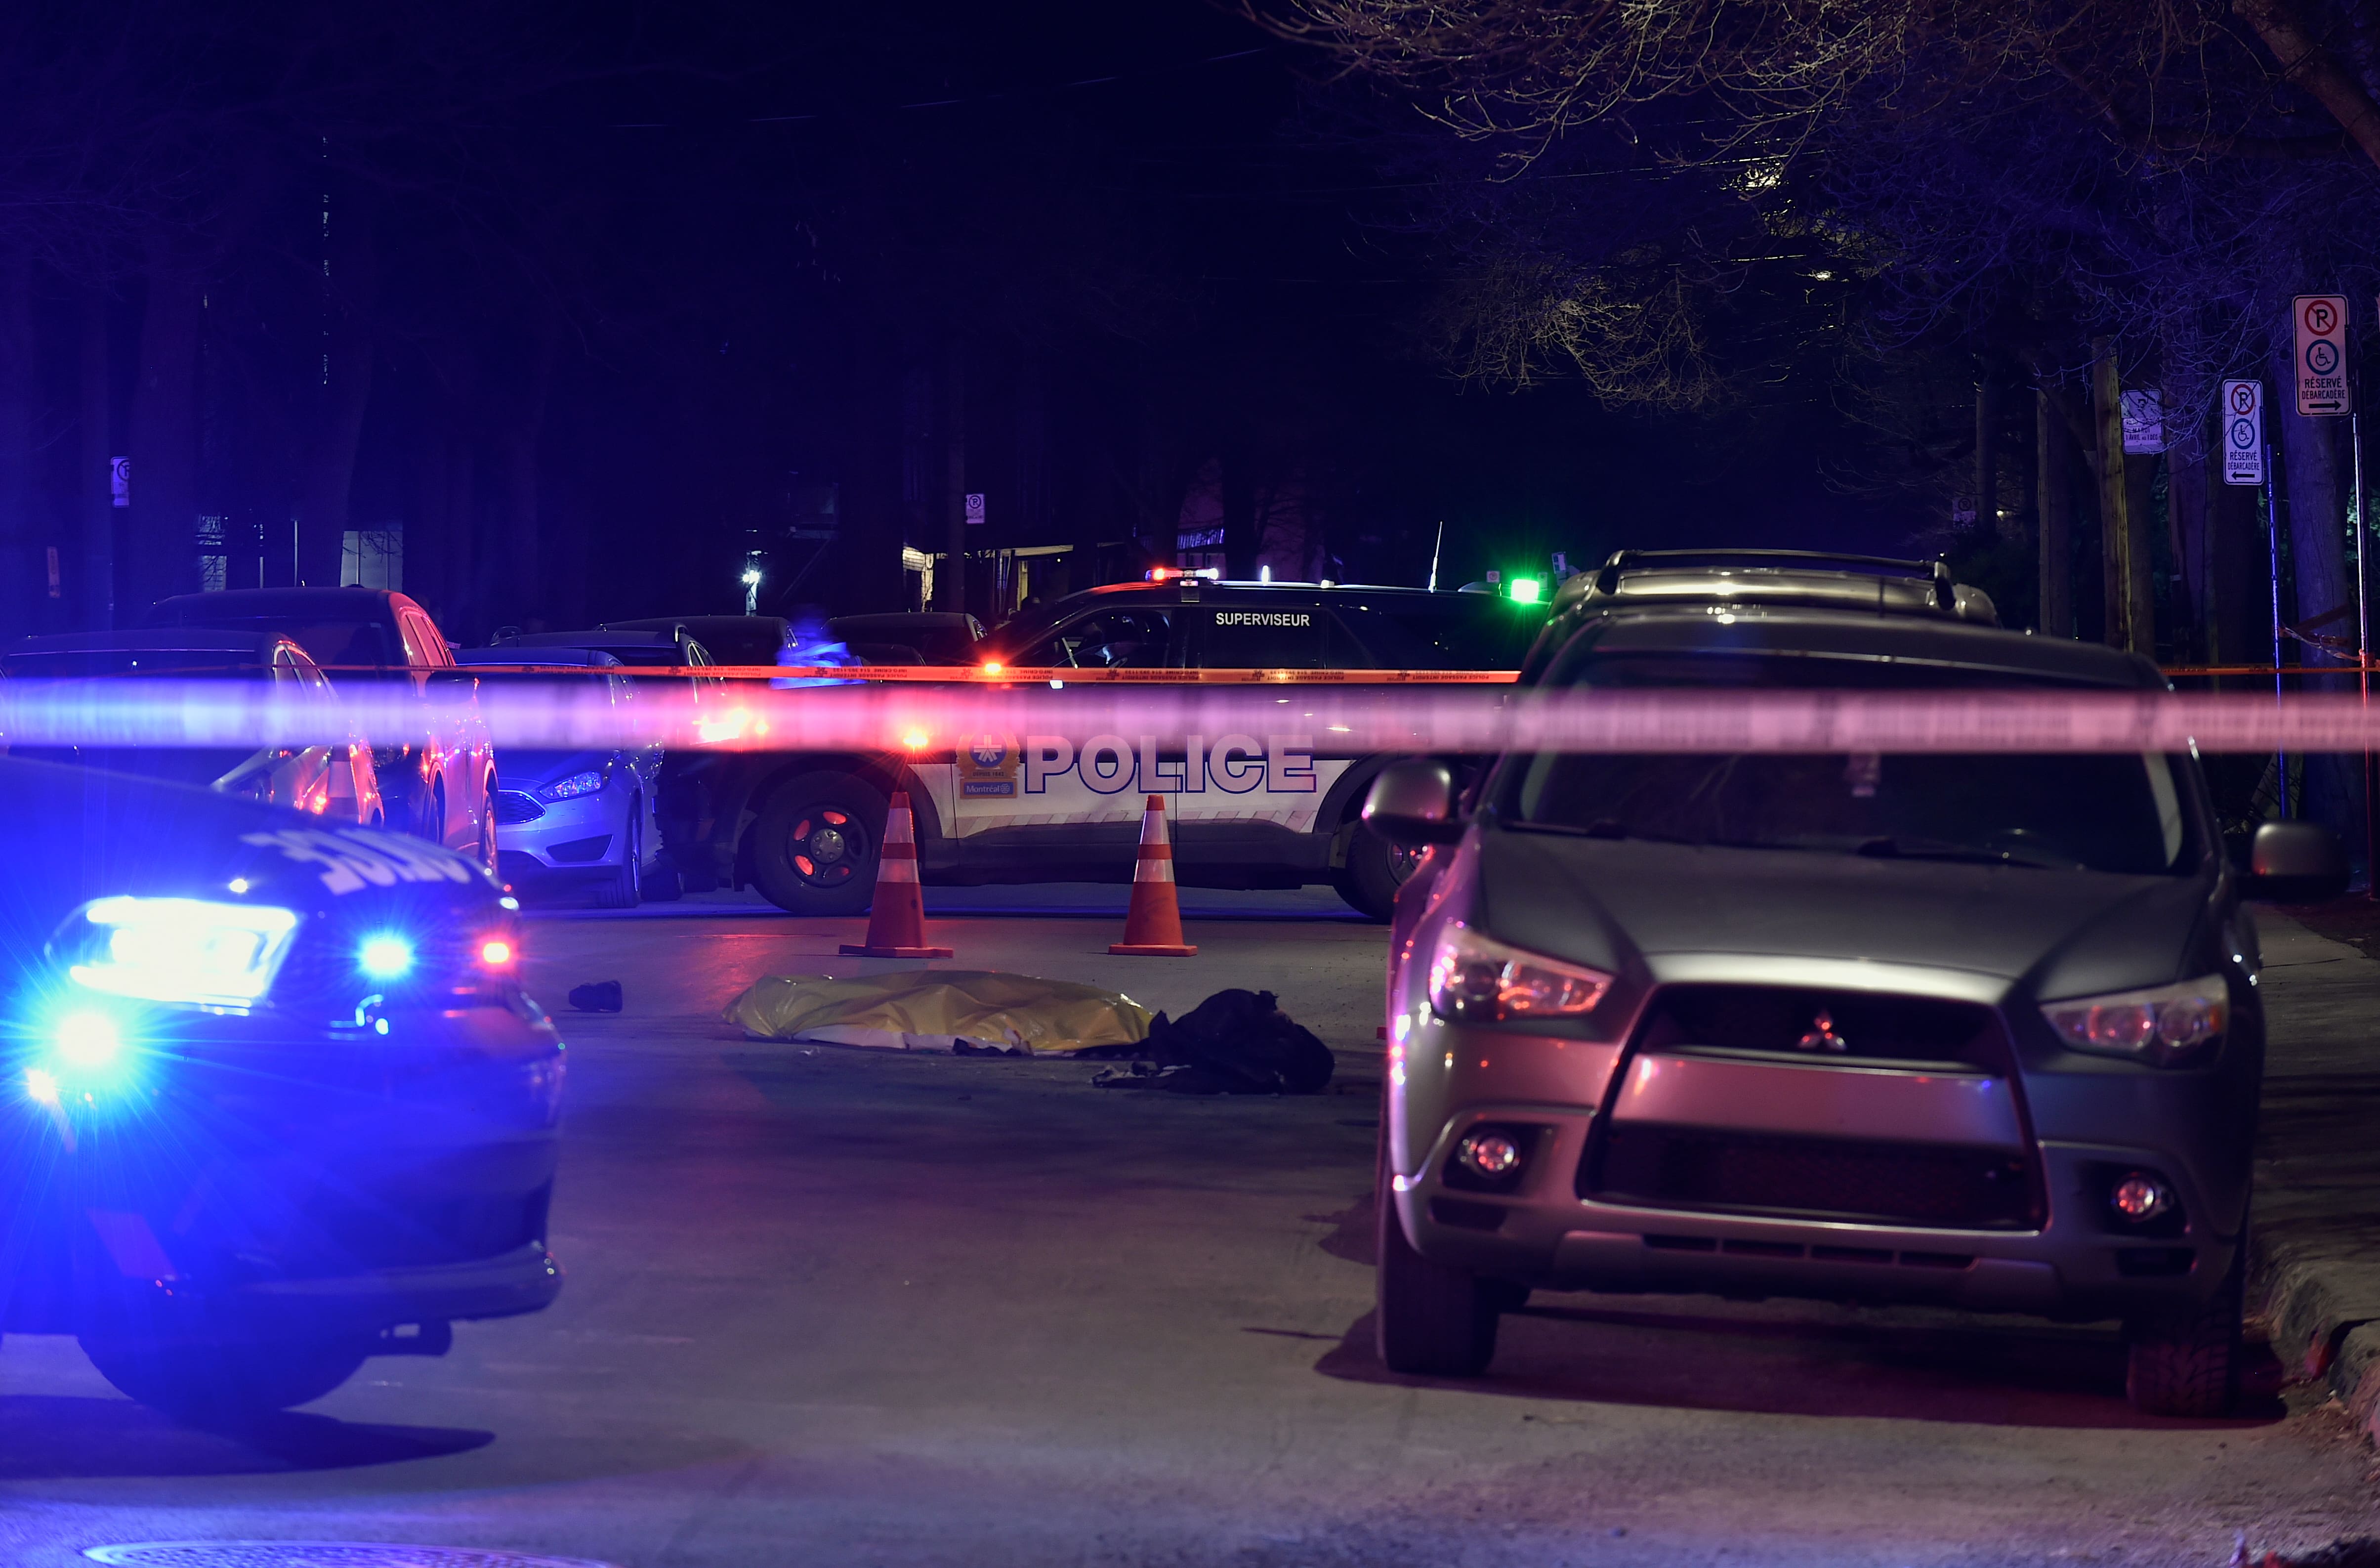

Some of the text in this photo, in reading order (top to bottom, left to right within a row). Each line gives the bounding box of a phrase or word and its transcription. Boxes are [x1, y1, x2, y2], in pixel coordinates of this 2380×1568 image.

[2304, 376, 2342, 388] RÉSERVÉ
[2302, 388, 2345, 399] DÉBARCADÈRE
[2230, 450, 2257, 461] RÉSERVÉ
[2227, 462, 2260, 470] DÉBARCADÈRE
[1215, 612, 1310, 627] SUPERVISEUR
[1025, 735, 1317, 794] POLICE
